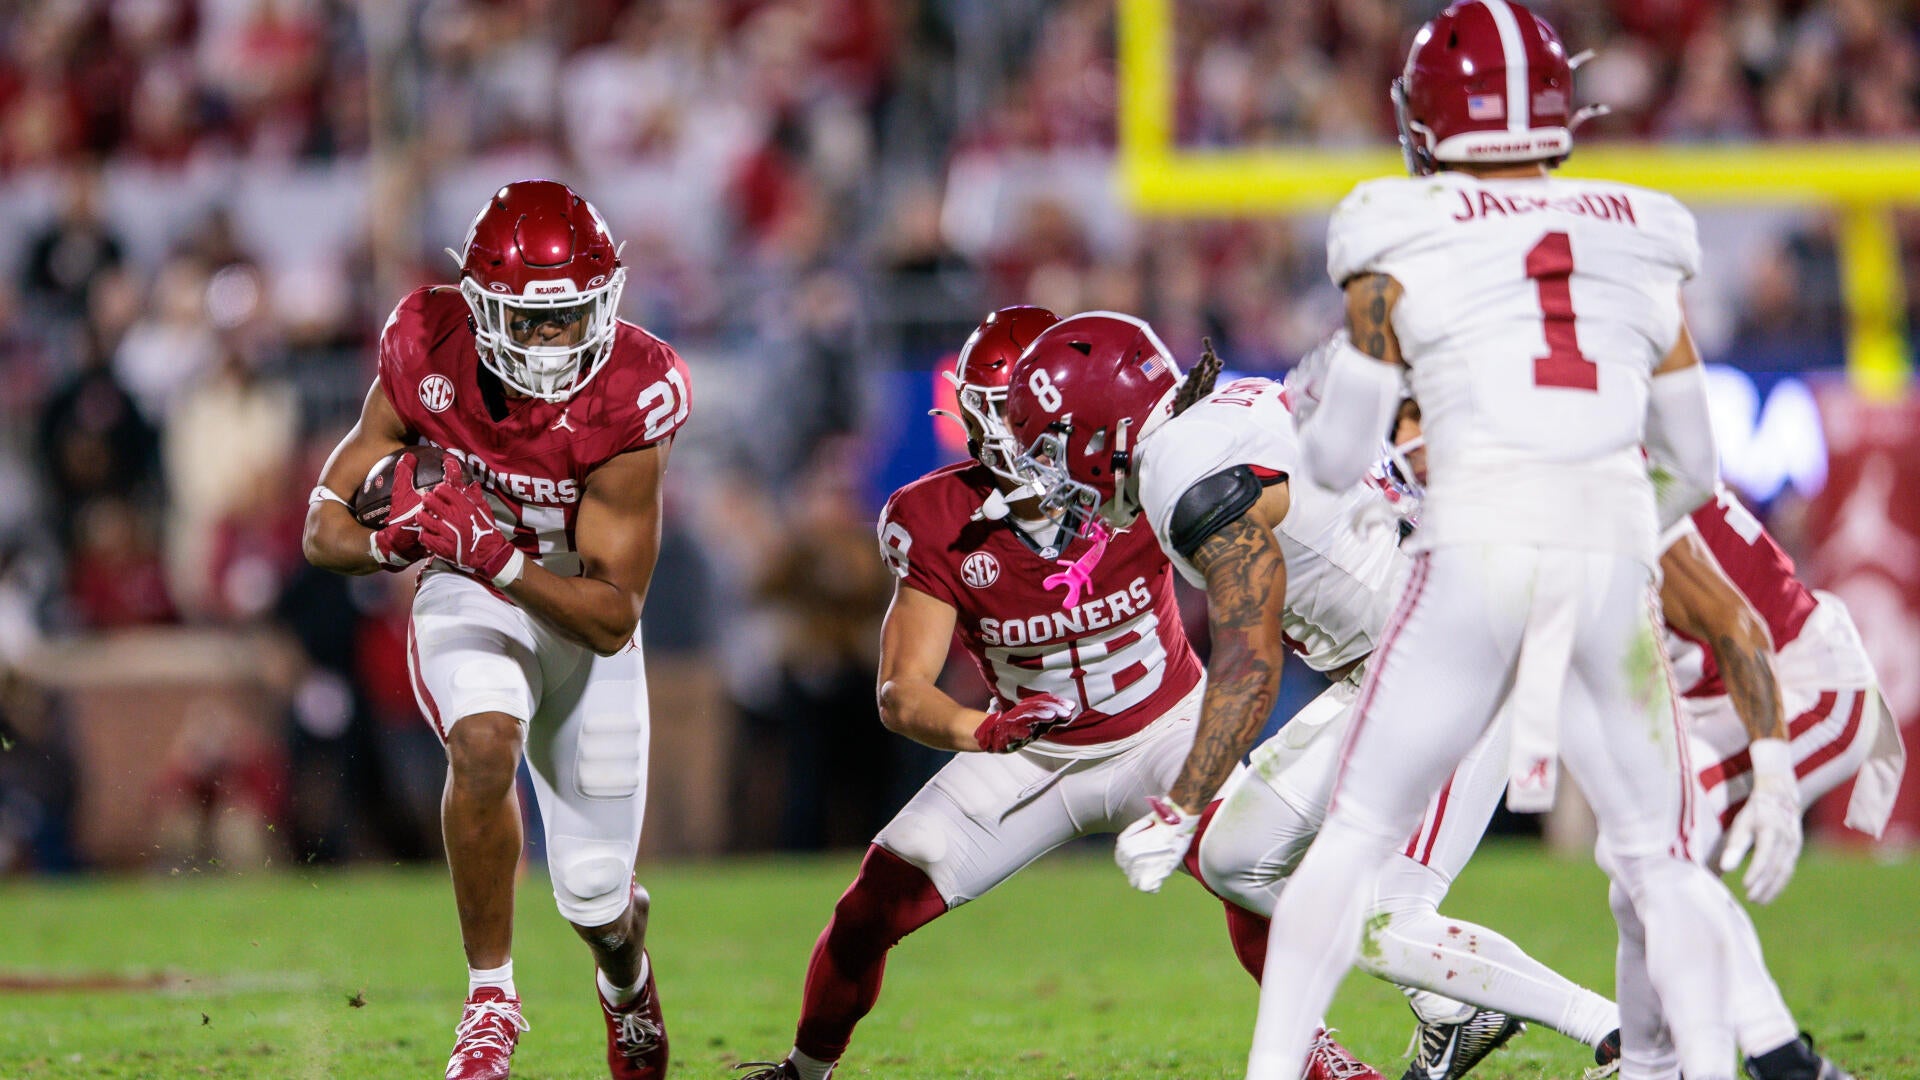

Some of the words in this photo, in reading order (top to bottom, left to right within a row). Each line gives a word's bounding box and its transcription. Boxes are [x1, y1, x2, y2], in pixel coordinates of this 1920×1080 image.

[535, 286, 566, 295] OKLAHOMA
[1526, 232, 1598, 391] 1
[420, 379, 454, 410] SEC
[637, 367, 690, 441] 21
[1028, 368, 1063, 413] 8
[418, 437, 577, 503] ONERS
[963, 554, 998, 587] SEC
[980, 577, 1152, 647] SOONERS
[985, 609, 1167, 728] 88
